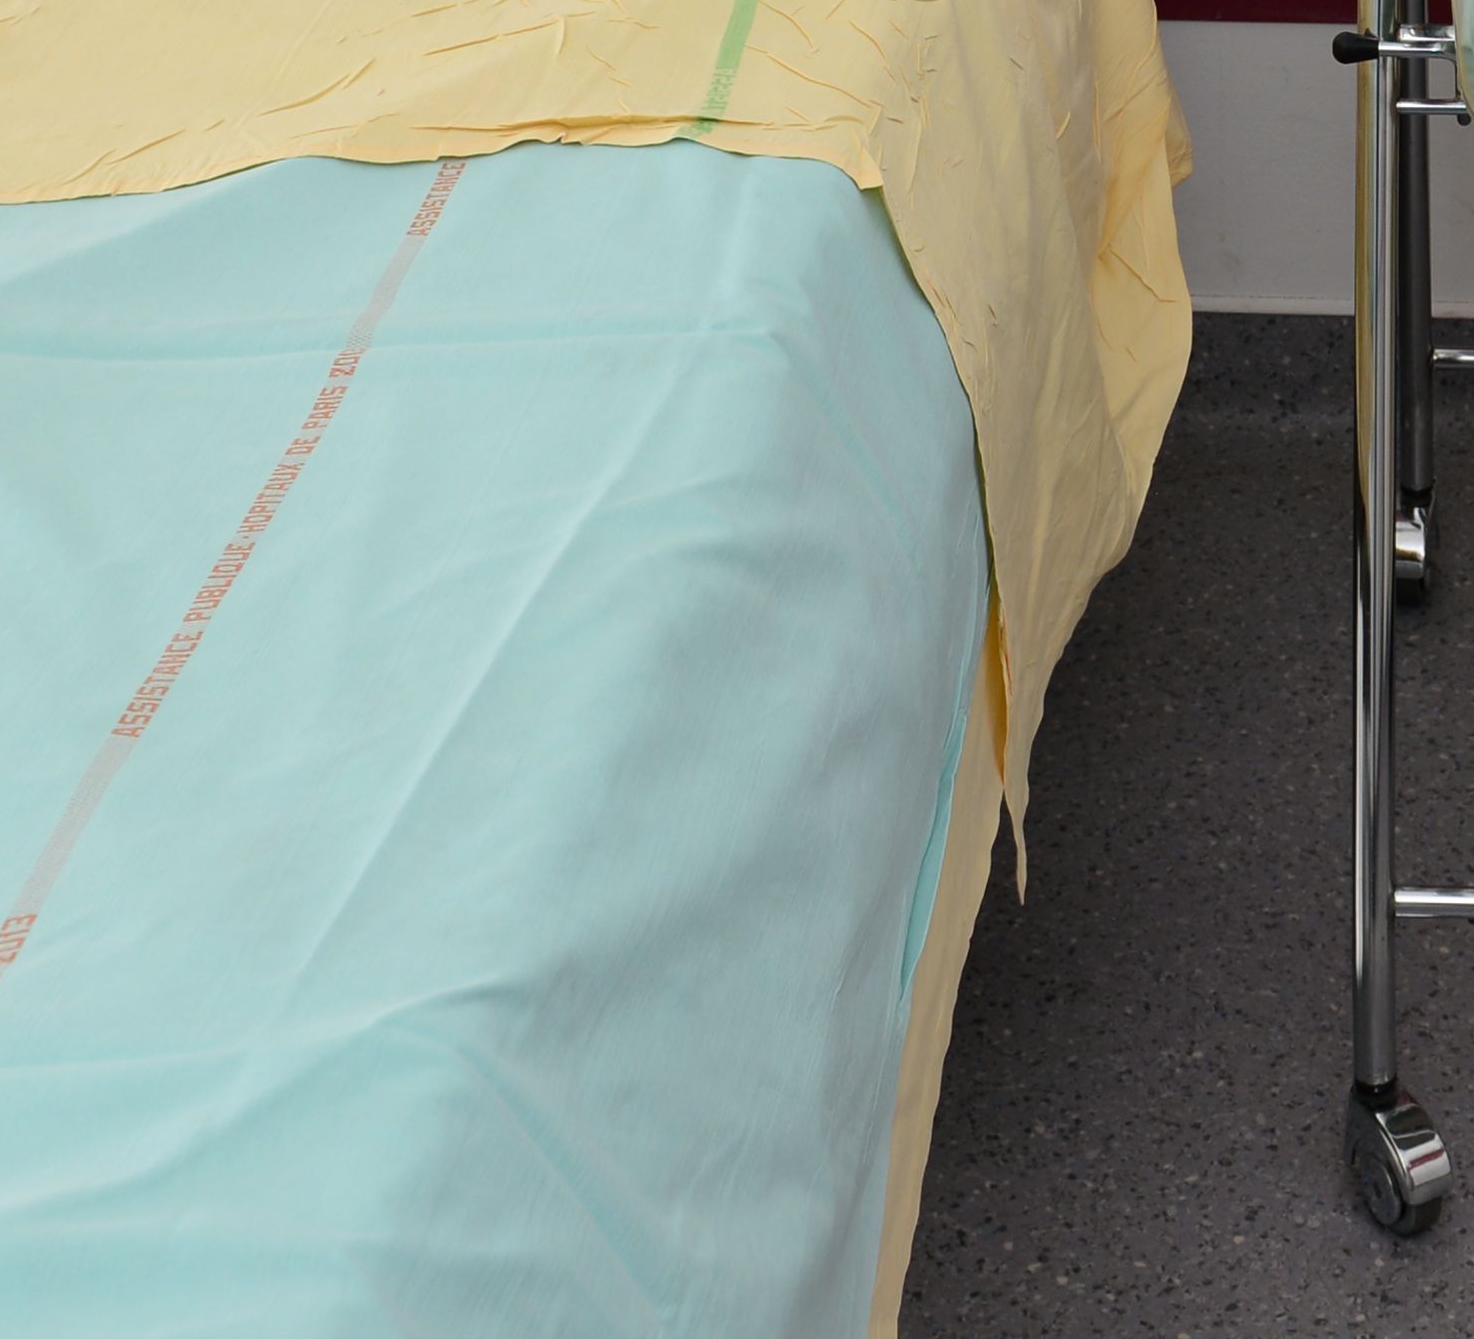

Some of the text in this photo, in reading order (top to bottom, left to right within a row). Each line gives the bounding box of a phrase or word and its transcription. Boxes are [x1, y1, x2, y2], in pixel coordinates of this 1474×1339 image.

[406, 162, 466, 237] ASSISTANCE
[301, 385, 348, 431] PARIS
[284, 435, 320, 456] DE
[110, 630, 204, 738] ASSISTANCE
